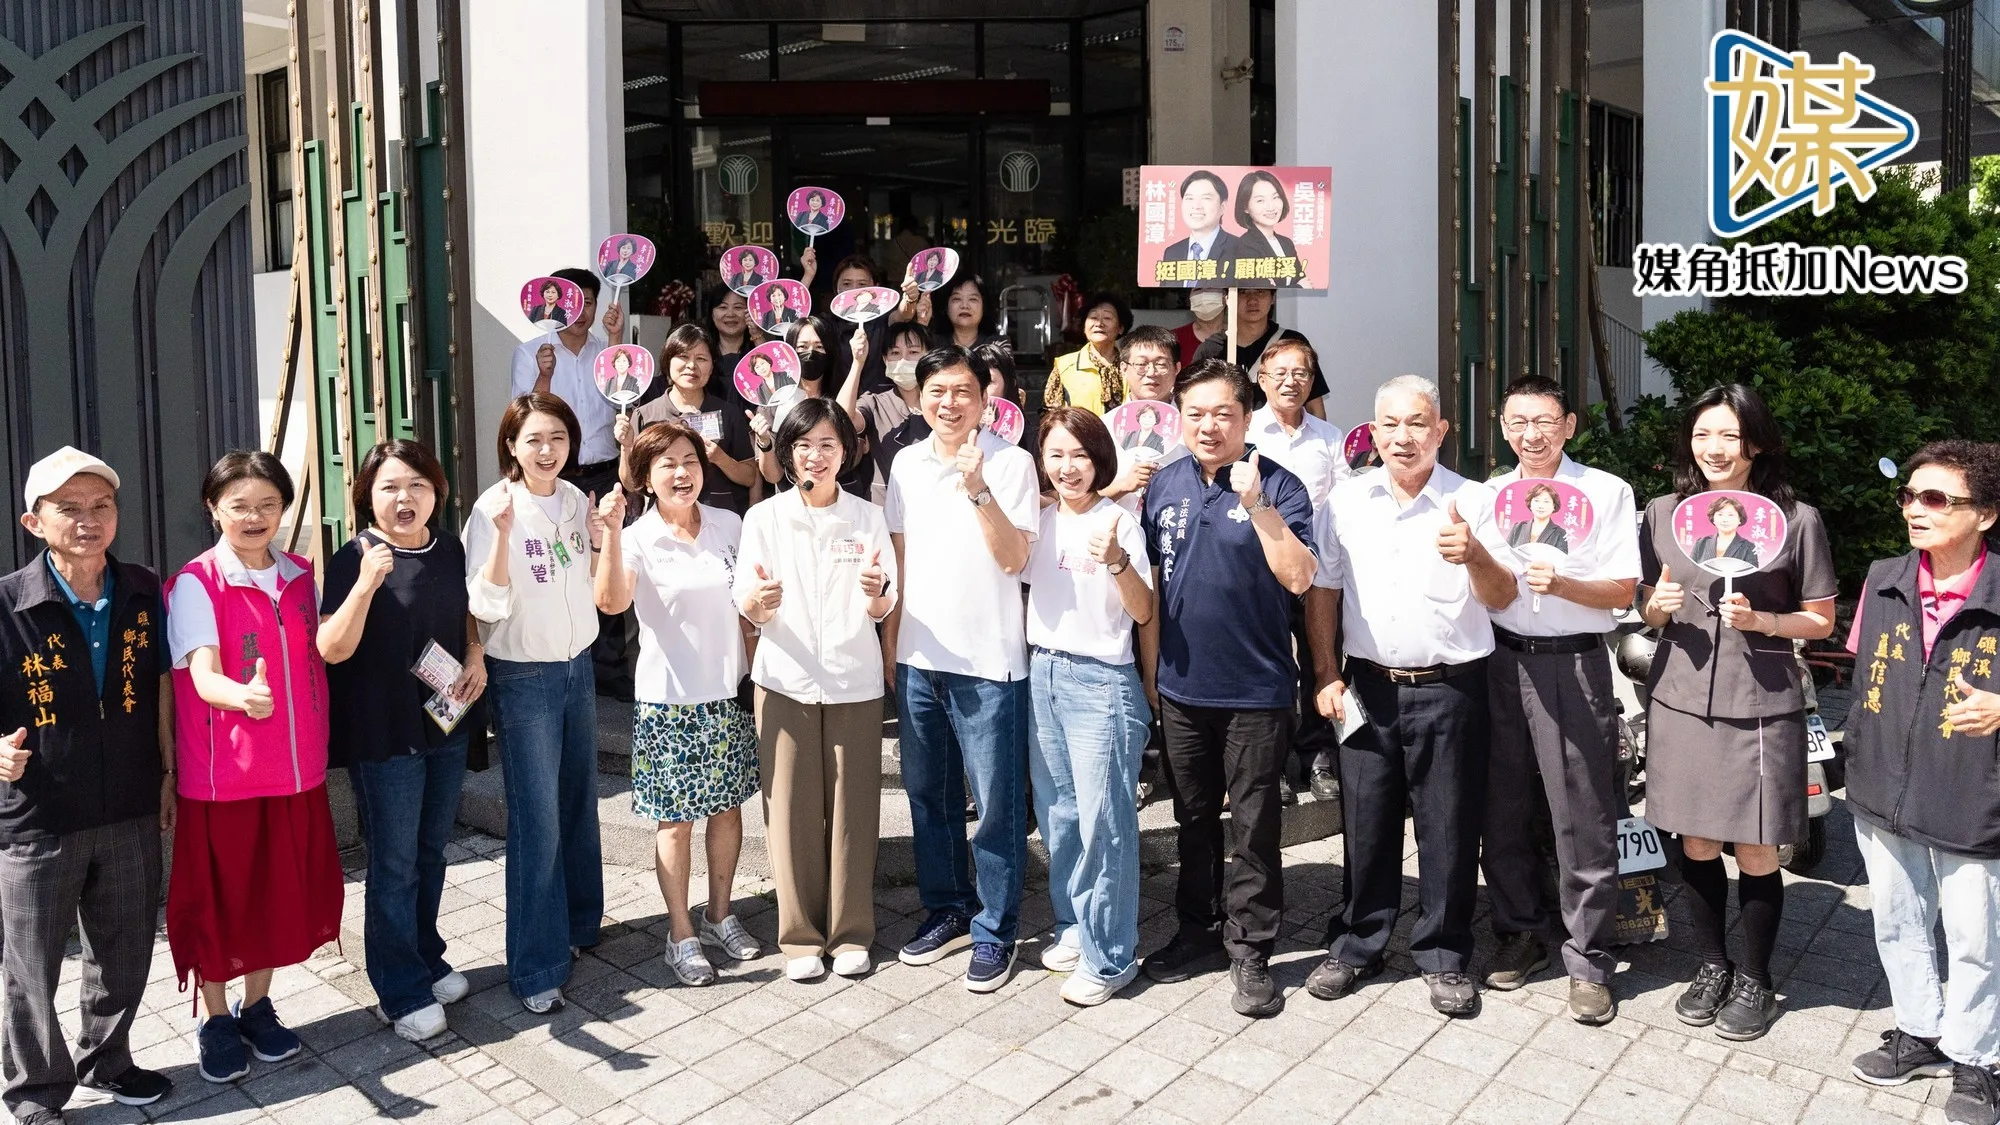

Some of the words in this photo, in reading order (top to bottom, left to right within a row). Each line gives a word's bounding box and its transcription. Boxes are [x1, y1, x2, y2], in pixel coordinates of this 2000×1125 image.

[987, 218, 1057, 245] 光臨
[1144, 180, 1166, 245] 林國漳
[704, 221, 774, 247] 歡迎
[1176, 498, 1191, 540] 立法委員
[1563, 495, 1580, 543] 李淑芬
[1751, 506, 1770, 557] 李淑芬
[137, 610, 150, 649] 礁溪
[1890, 622, 1911, 661] 代表
[47, 633, 68, 671] 代表
[122, 628, 137, 713] 鄉民代表會
[1972, 636, 1997, 679] 礁溪
[22, 653, 56, 727] 林福山
[1617, 829, 1659, 859] 790
